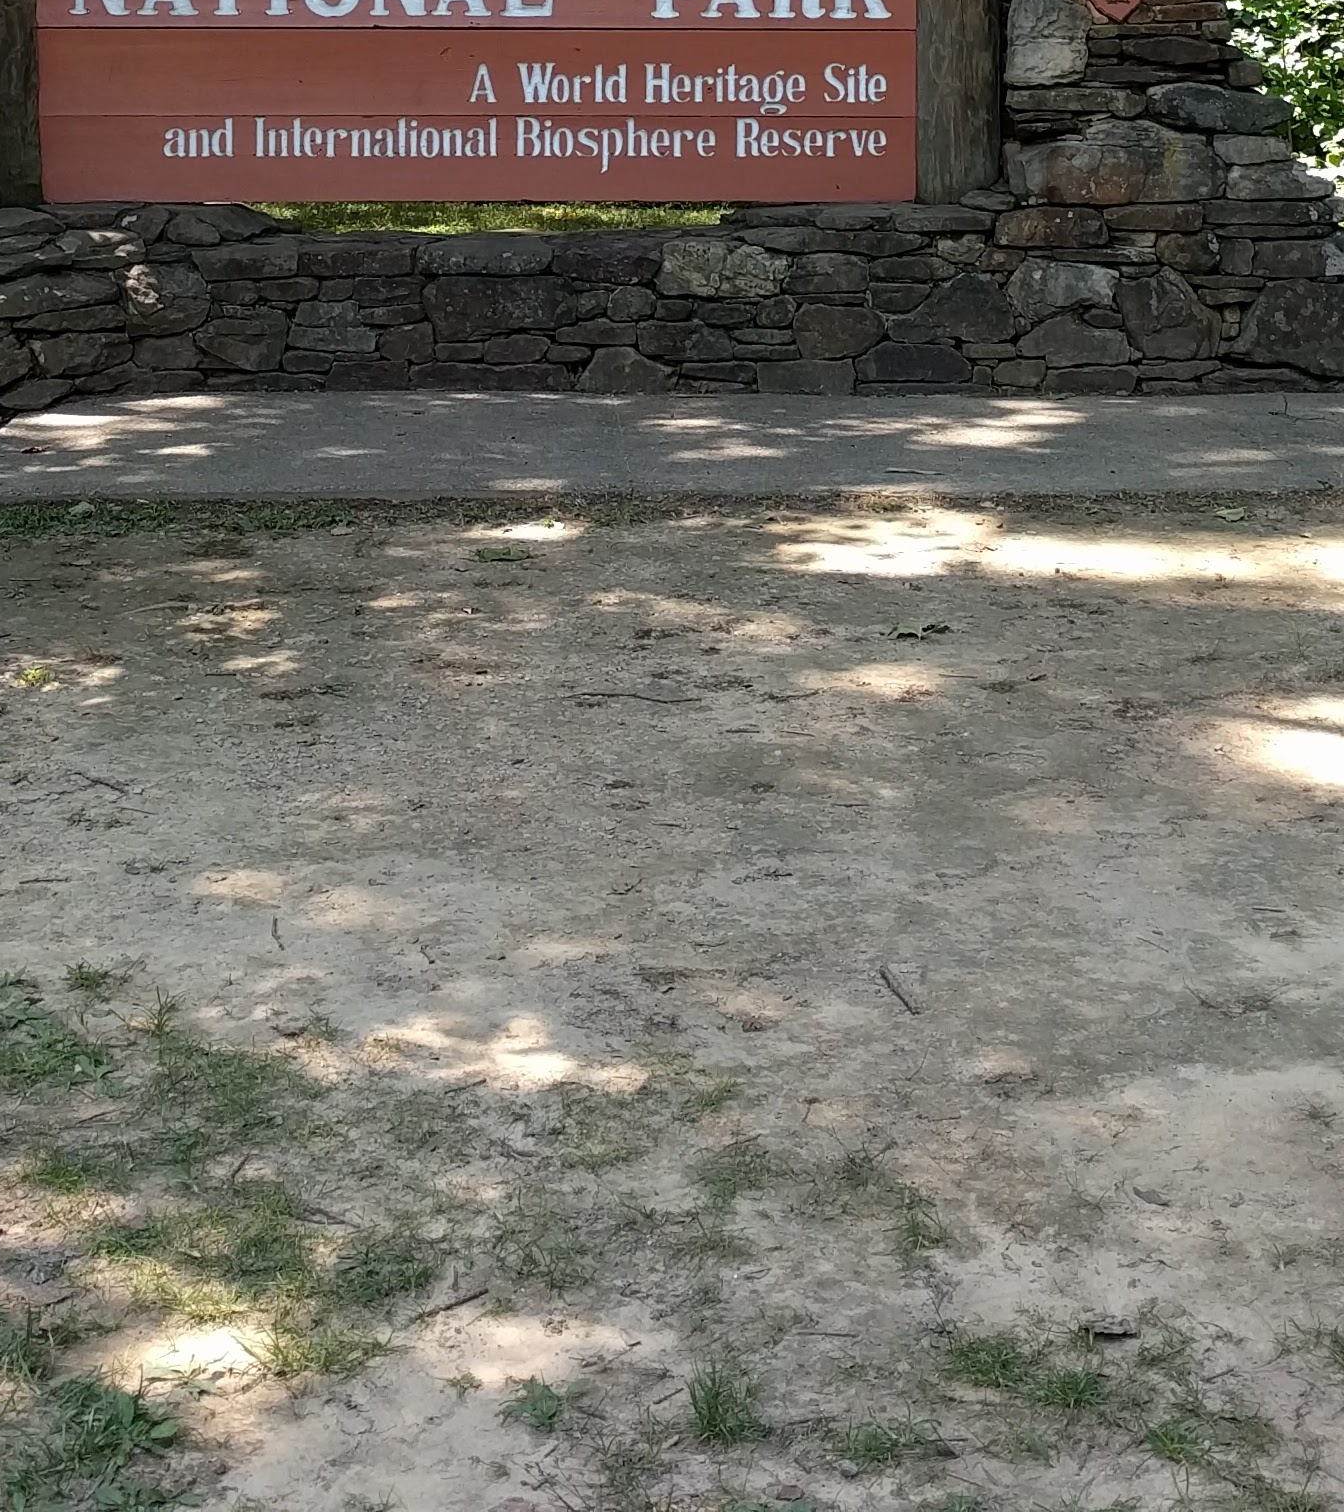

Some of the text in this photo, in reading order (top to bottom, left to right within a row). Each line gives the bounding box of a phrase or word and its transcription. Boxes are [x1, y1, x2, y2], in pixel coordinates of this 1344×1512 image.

[469, 63, 887, 115] A World Heritage Site
[163, 117, 887, 173] and International Biosphere Reserve
